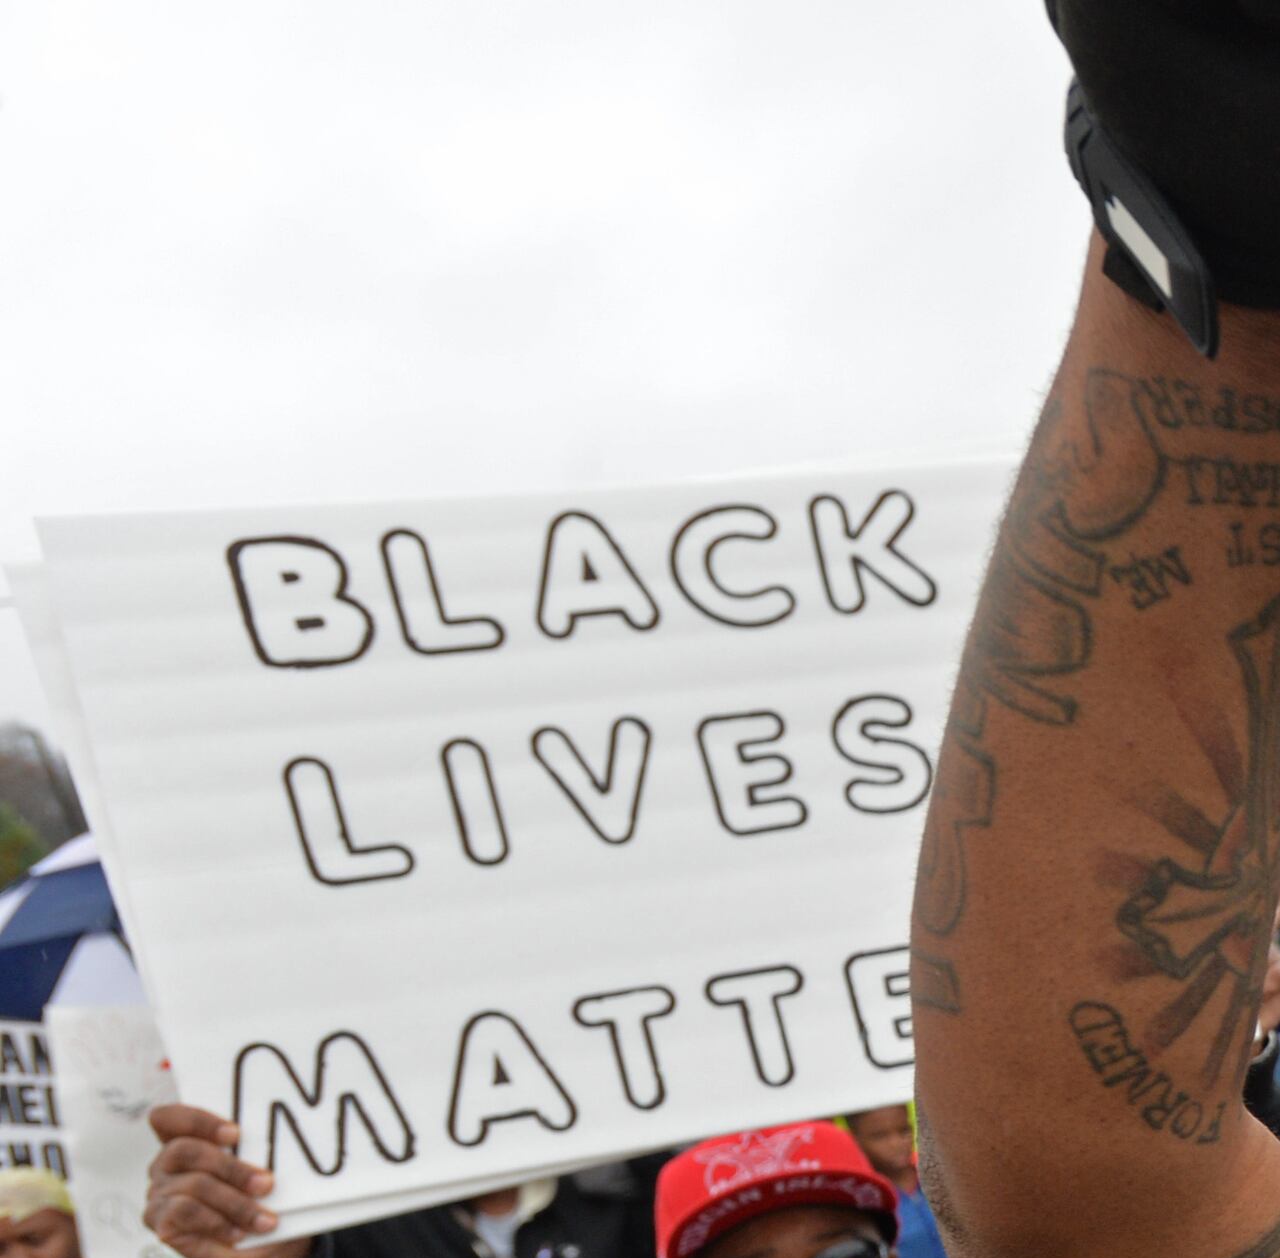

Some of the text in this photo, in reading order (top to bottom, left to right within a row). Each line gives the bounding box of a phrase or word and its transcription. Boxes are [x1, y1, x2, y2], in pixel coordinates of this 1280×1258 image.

[226, 488, 938, 669] BLACK
[282, 693, 935, 887] LIVES
[1068, 1001, 1227, 1145] FORMED
